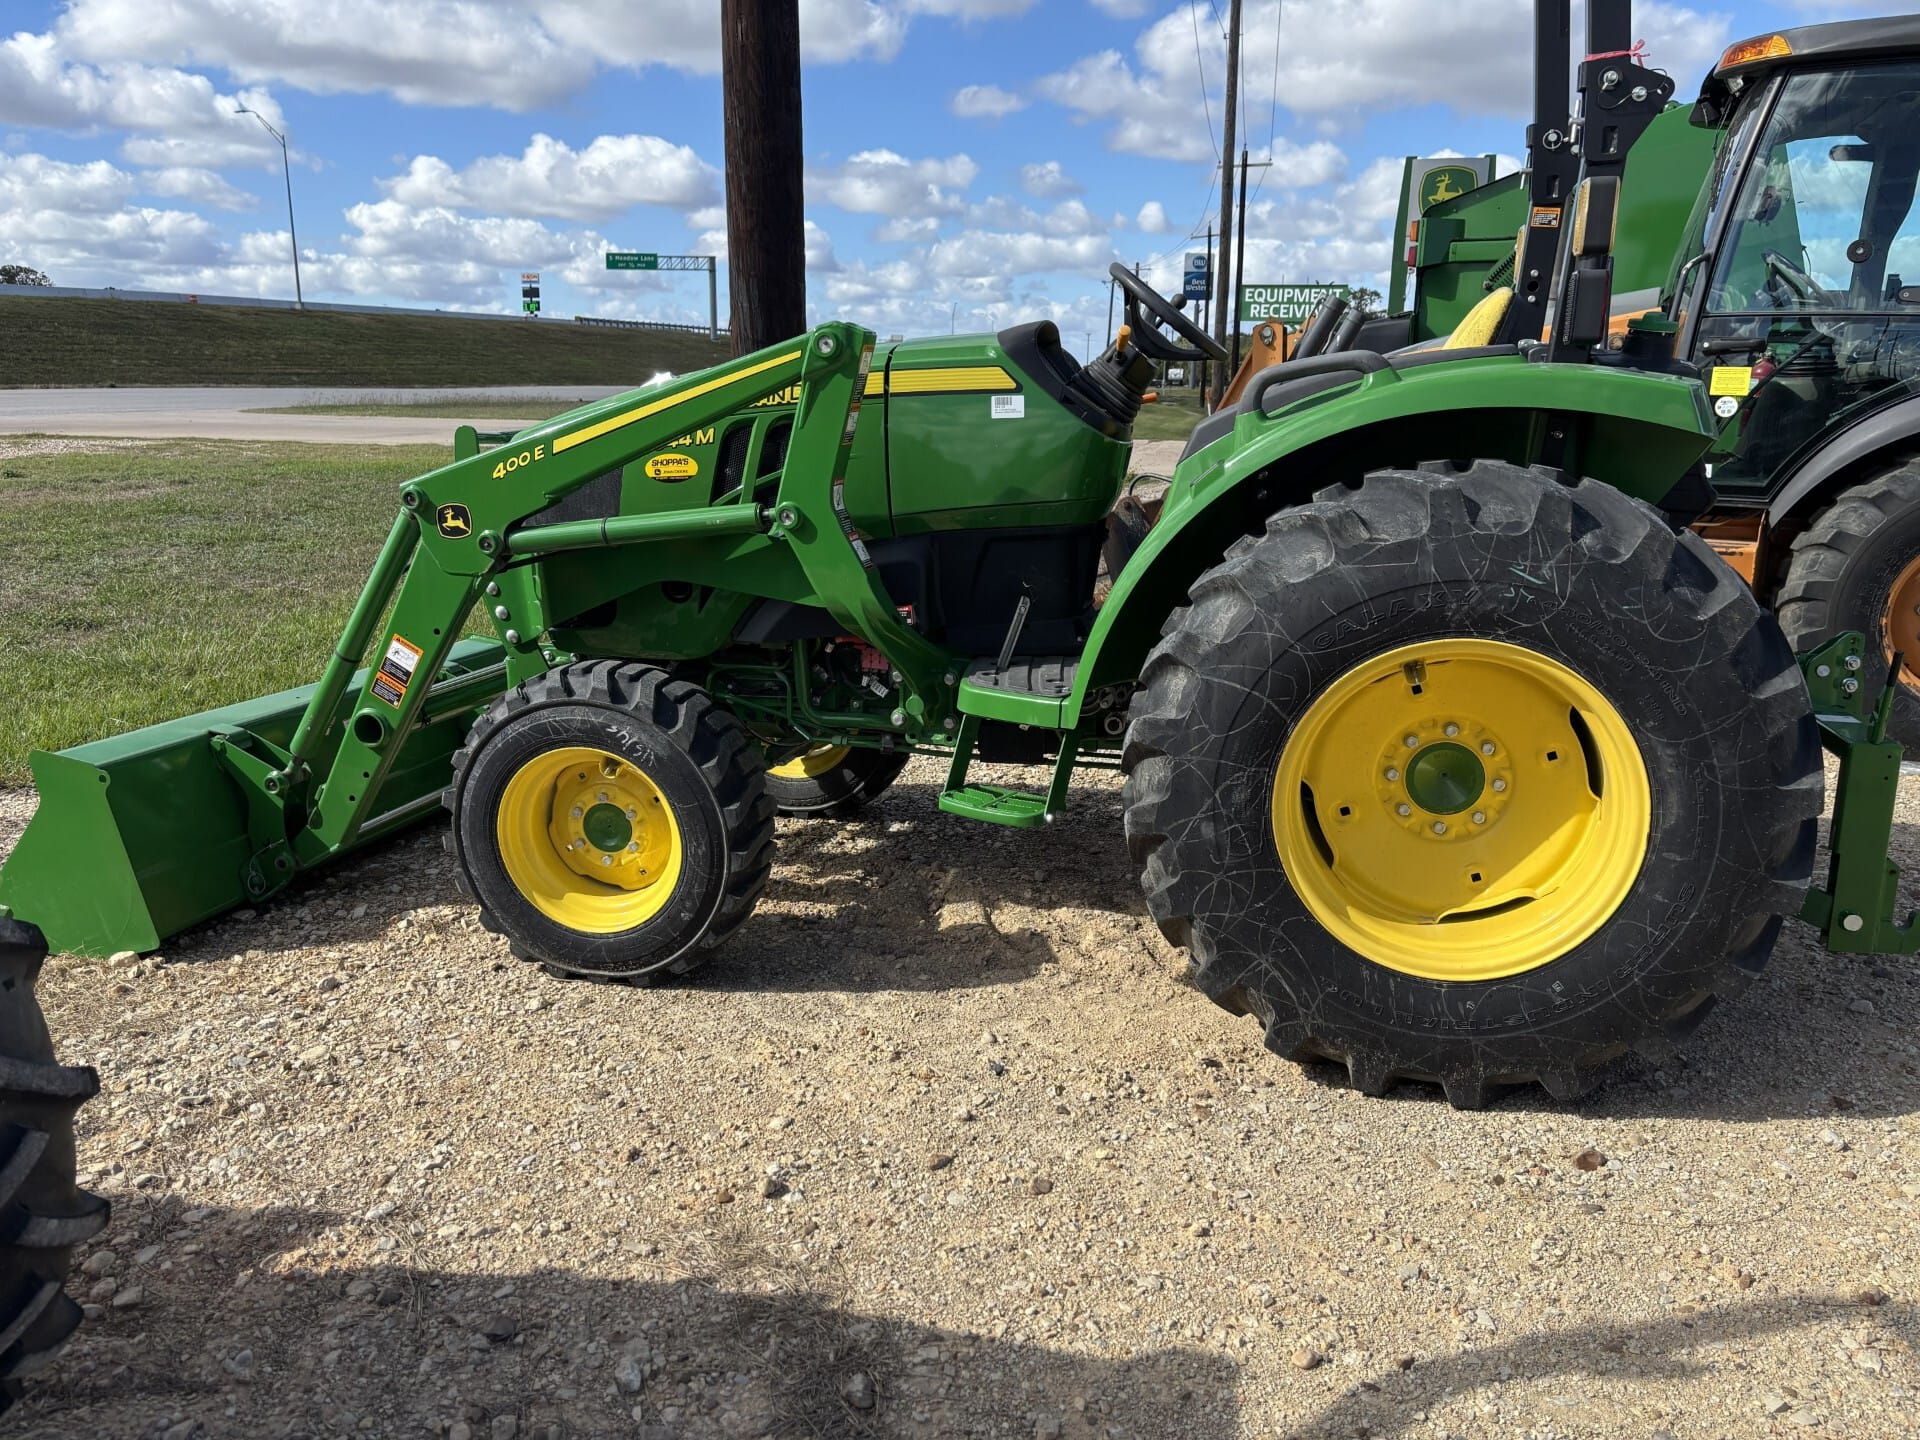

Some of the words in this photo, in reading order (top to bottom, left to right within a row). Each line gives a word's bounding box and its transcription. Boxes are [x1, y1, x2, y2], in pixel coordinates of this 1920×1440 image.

[1250, 303, 1322, 318] RECEIVIN
[492, 451, 531, 480] 400
[534, 444, 545, 461] E
[651, 458, 689, 467] SHOPPA'S
